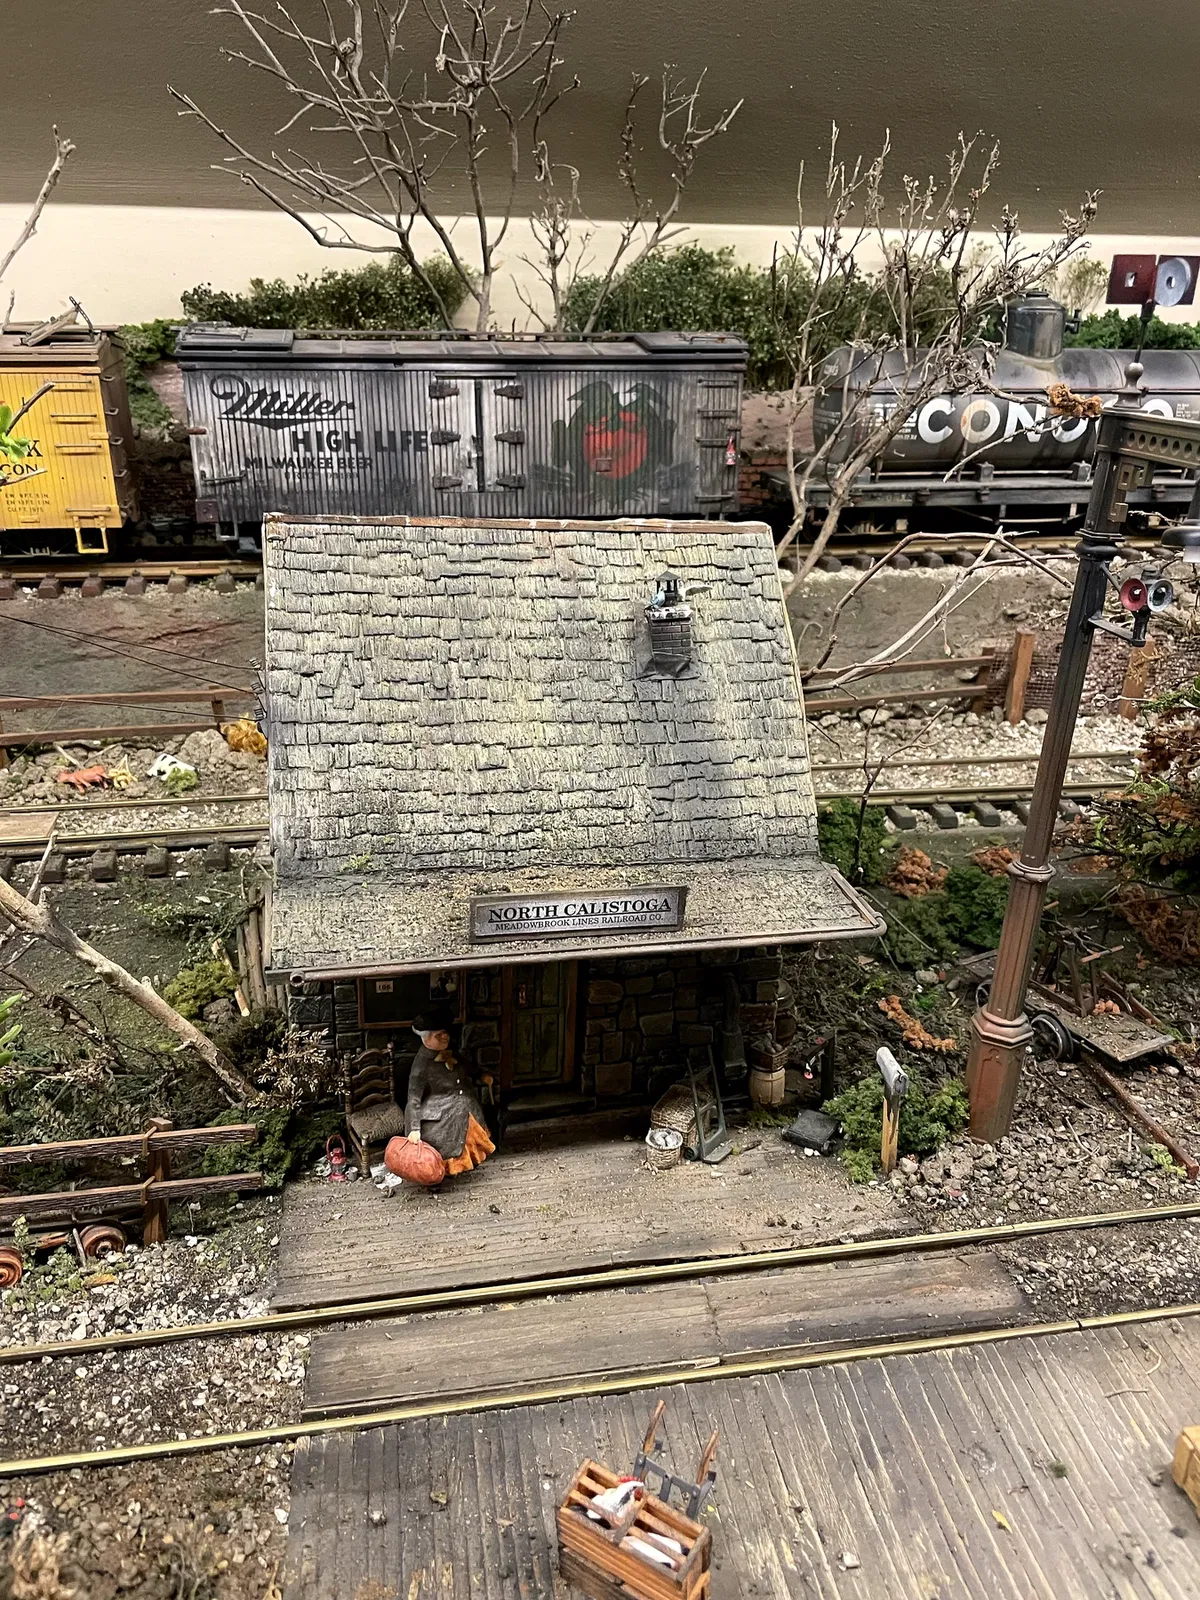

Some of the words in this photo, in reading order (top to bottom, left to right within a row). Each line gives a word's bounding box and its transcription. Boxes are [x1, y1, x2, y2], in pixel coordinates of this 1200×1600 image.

[210, 374, 356, 416] Miller
[918, 398, 1174, 444] CONO
[292, 430, 363, 452] HIGH
[375, 430, 428, 452] LIFE
[244, 457, 334, 469] MILWAUKEE
[338, 457, 372, 469] BEER
[489, 904, 560, 921] NORTH
[563, 898, 671, 917] CALISTOGA
[494, 918, 571, 931] MEADOWBROOK
[572, 916, 600, 927] LINES
[601, 913, 647, 924] RAILROAD
[649, 913, 664, 921] CO.
